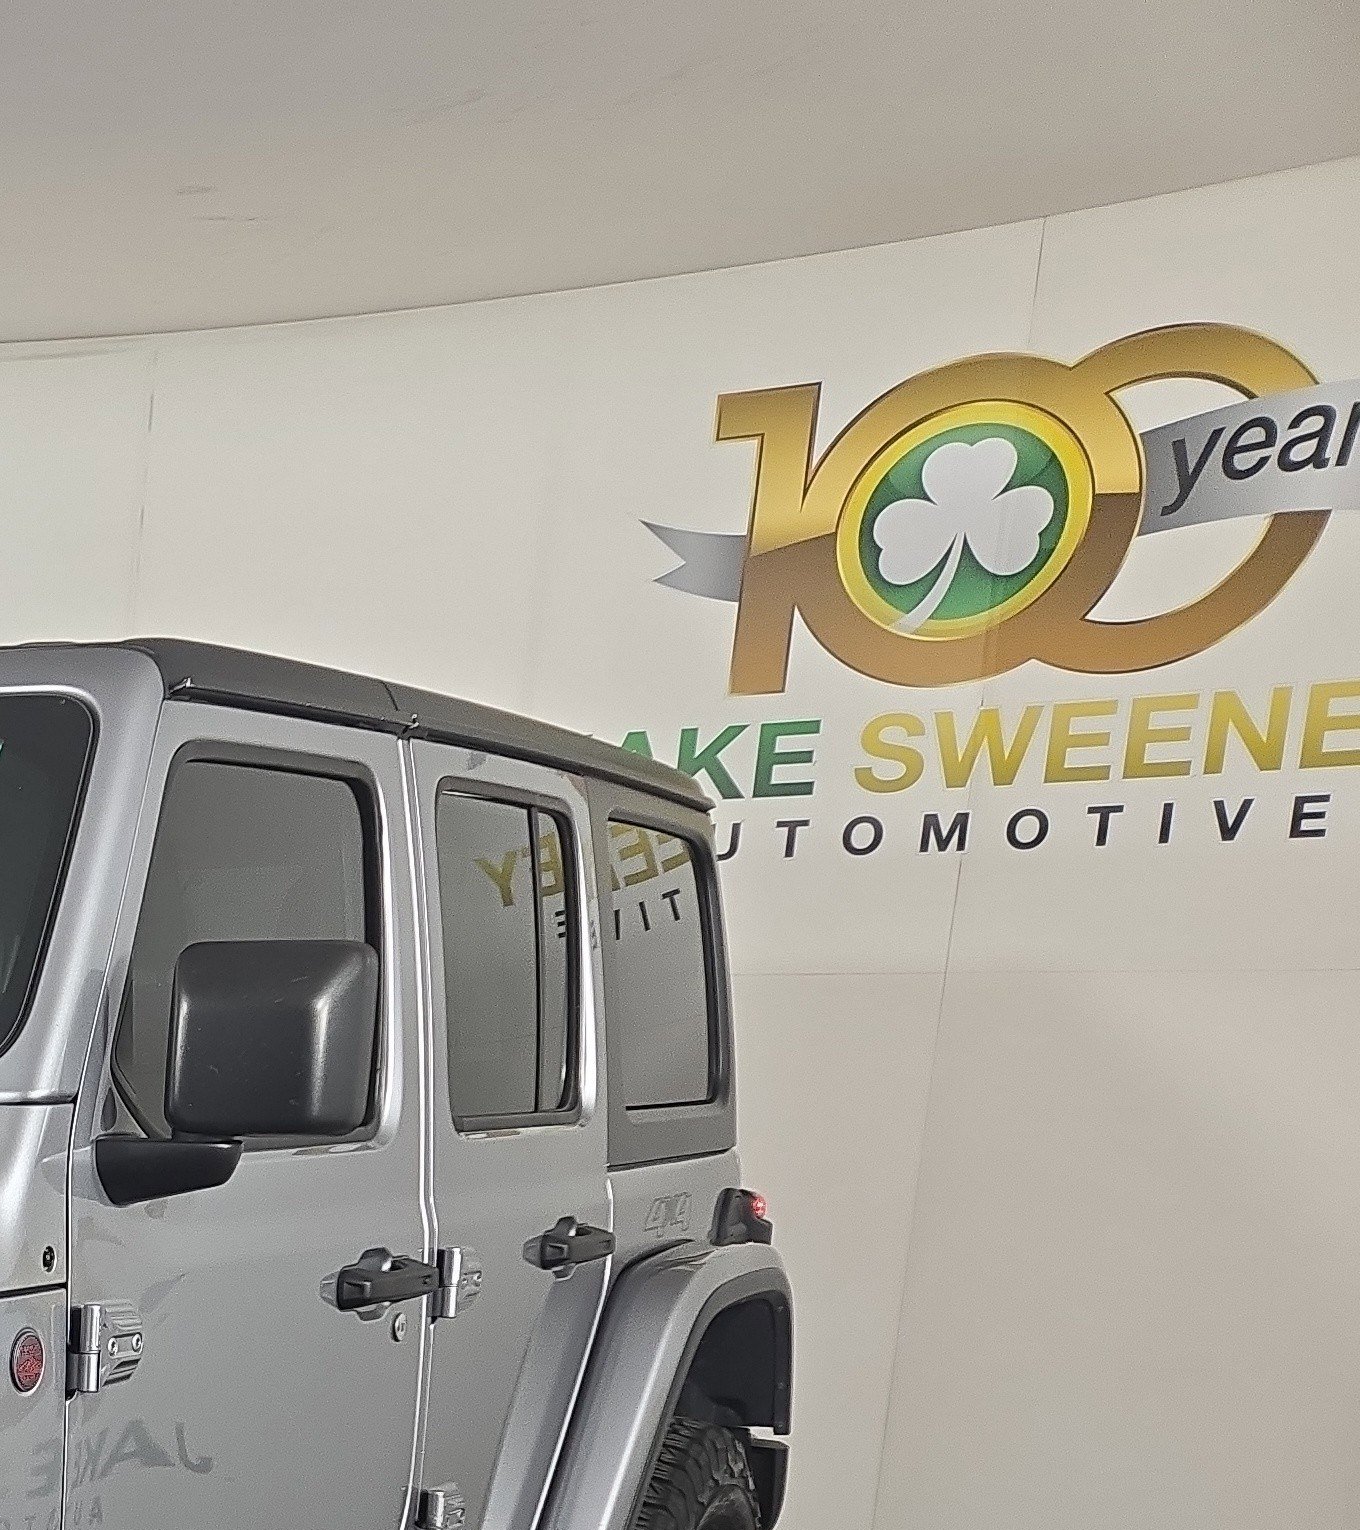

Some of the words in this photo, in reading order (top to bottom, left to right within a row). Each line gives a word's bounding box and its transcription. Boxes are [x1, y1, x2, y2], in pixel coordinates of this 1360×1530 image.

[715, 322, 1336, 697] 100
[621, 719, 822, 800] KE
[714, 793, 1332, 862] UTOMOTIVE
